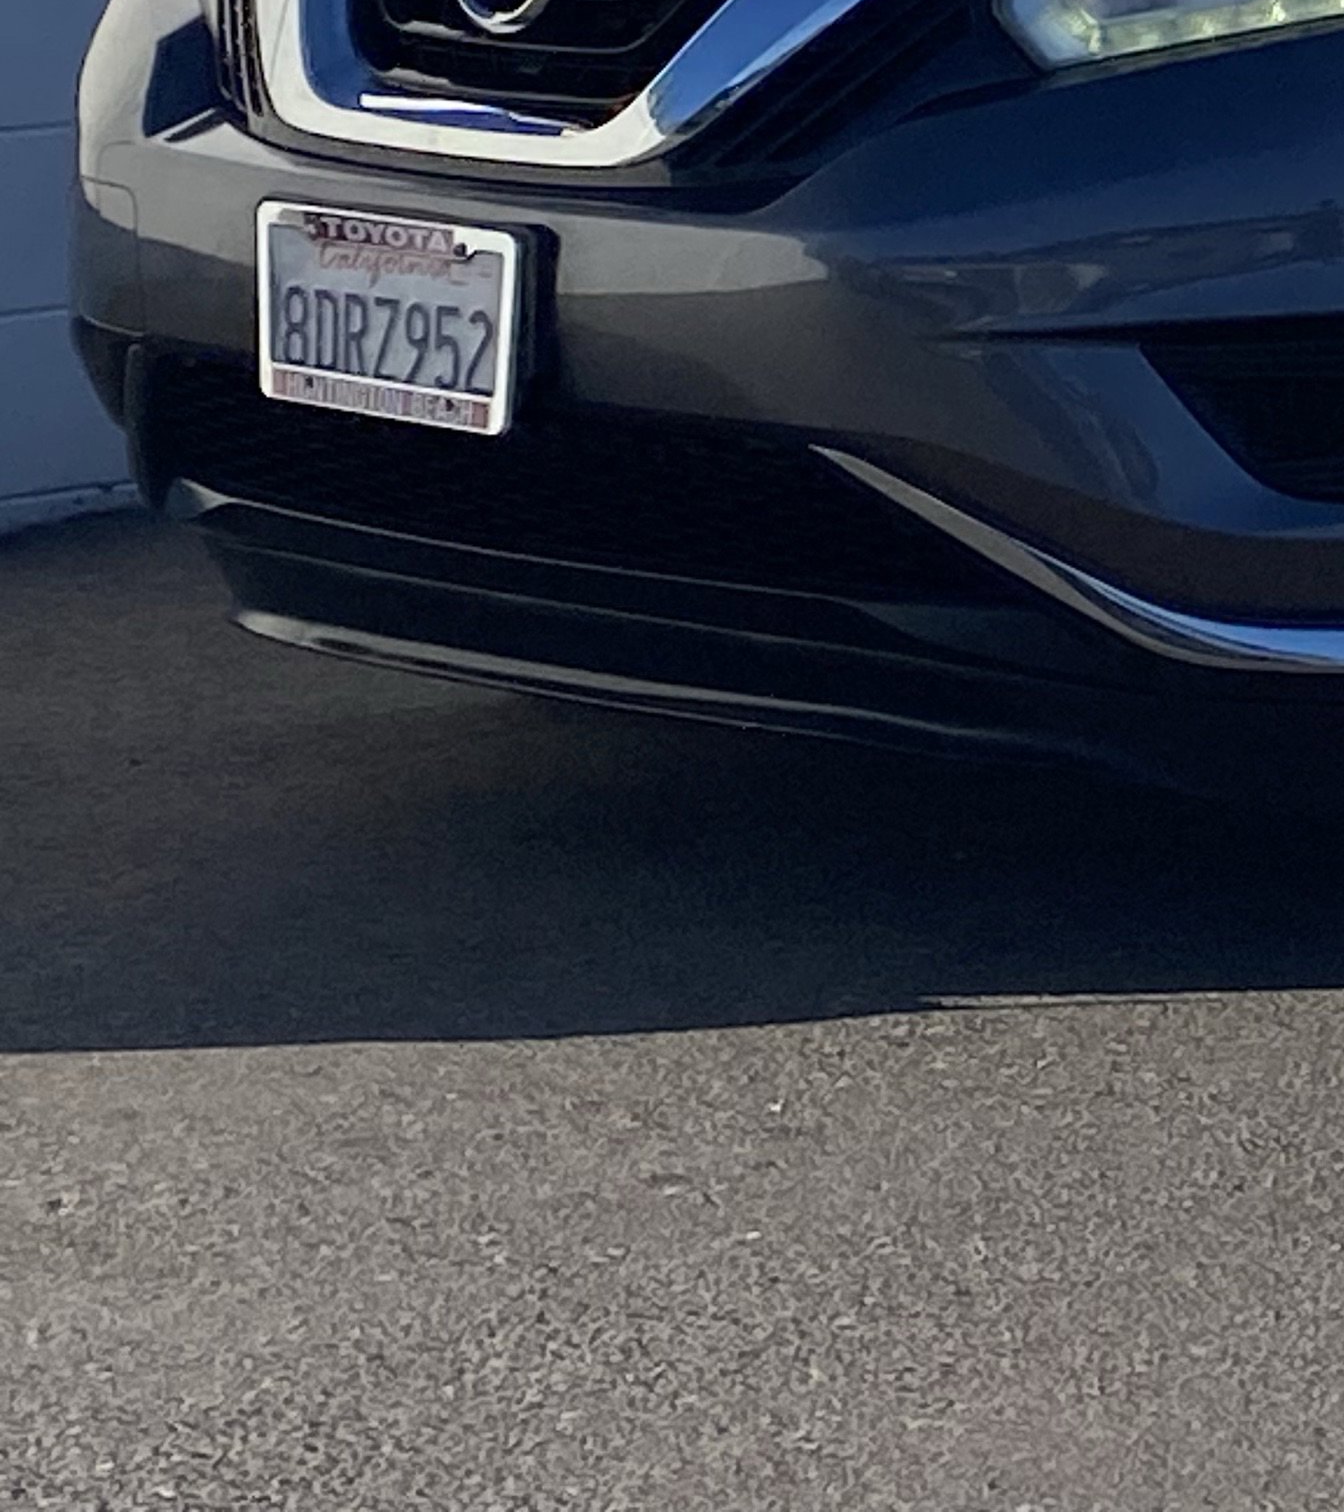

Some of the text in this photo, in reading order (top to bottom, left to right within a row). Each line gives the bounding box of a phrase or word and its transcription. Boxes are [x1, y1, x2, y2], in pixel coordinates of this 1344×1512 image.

[320, 216, 449, 253] TOYOTA
[319, 241, 453, 288] California
[283, 285, 495, 396] 8DRZ952
